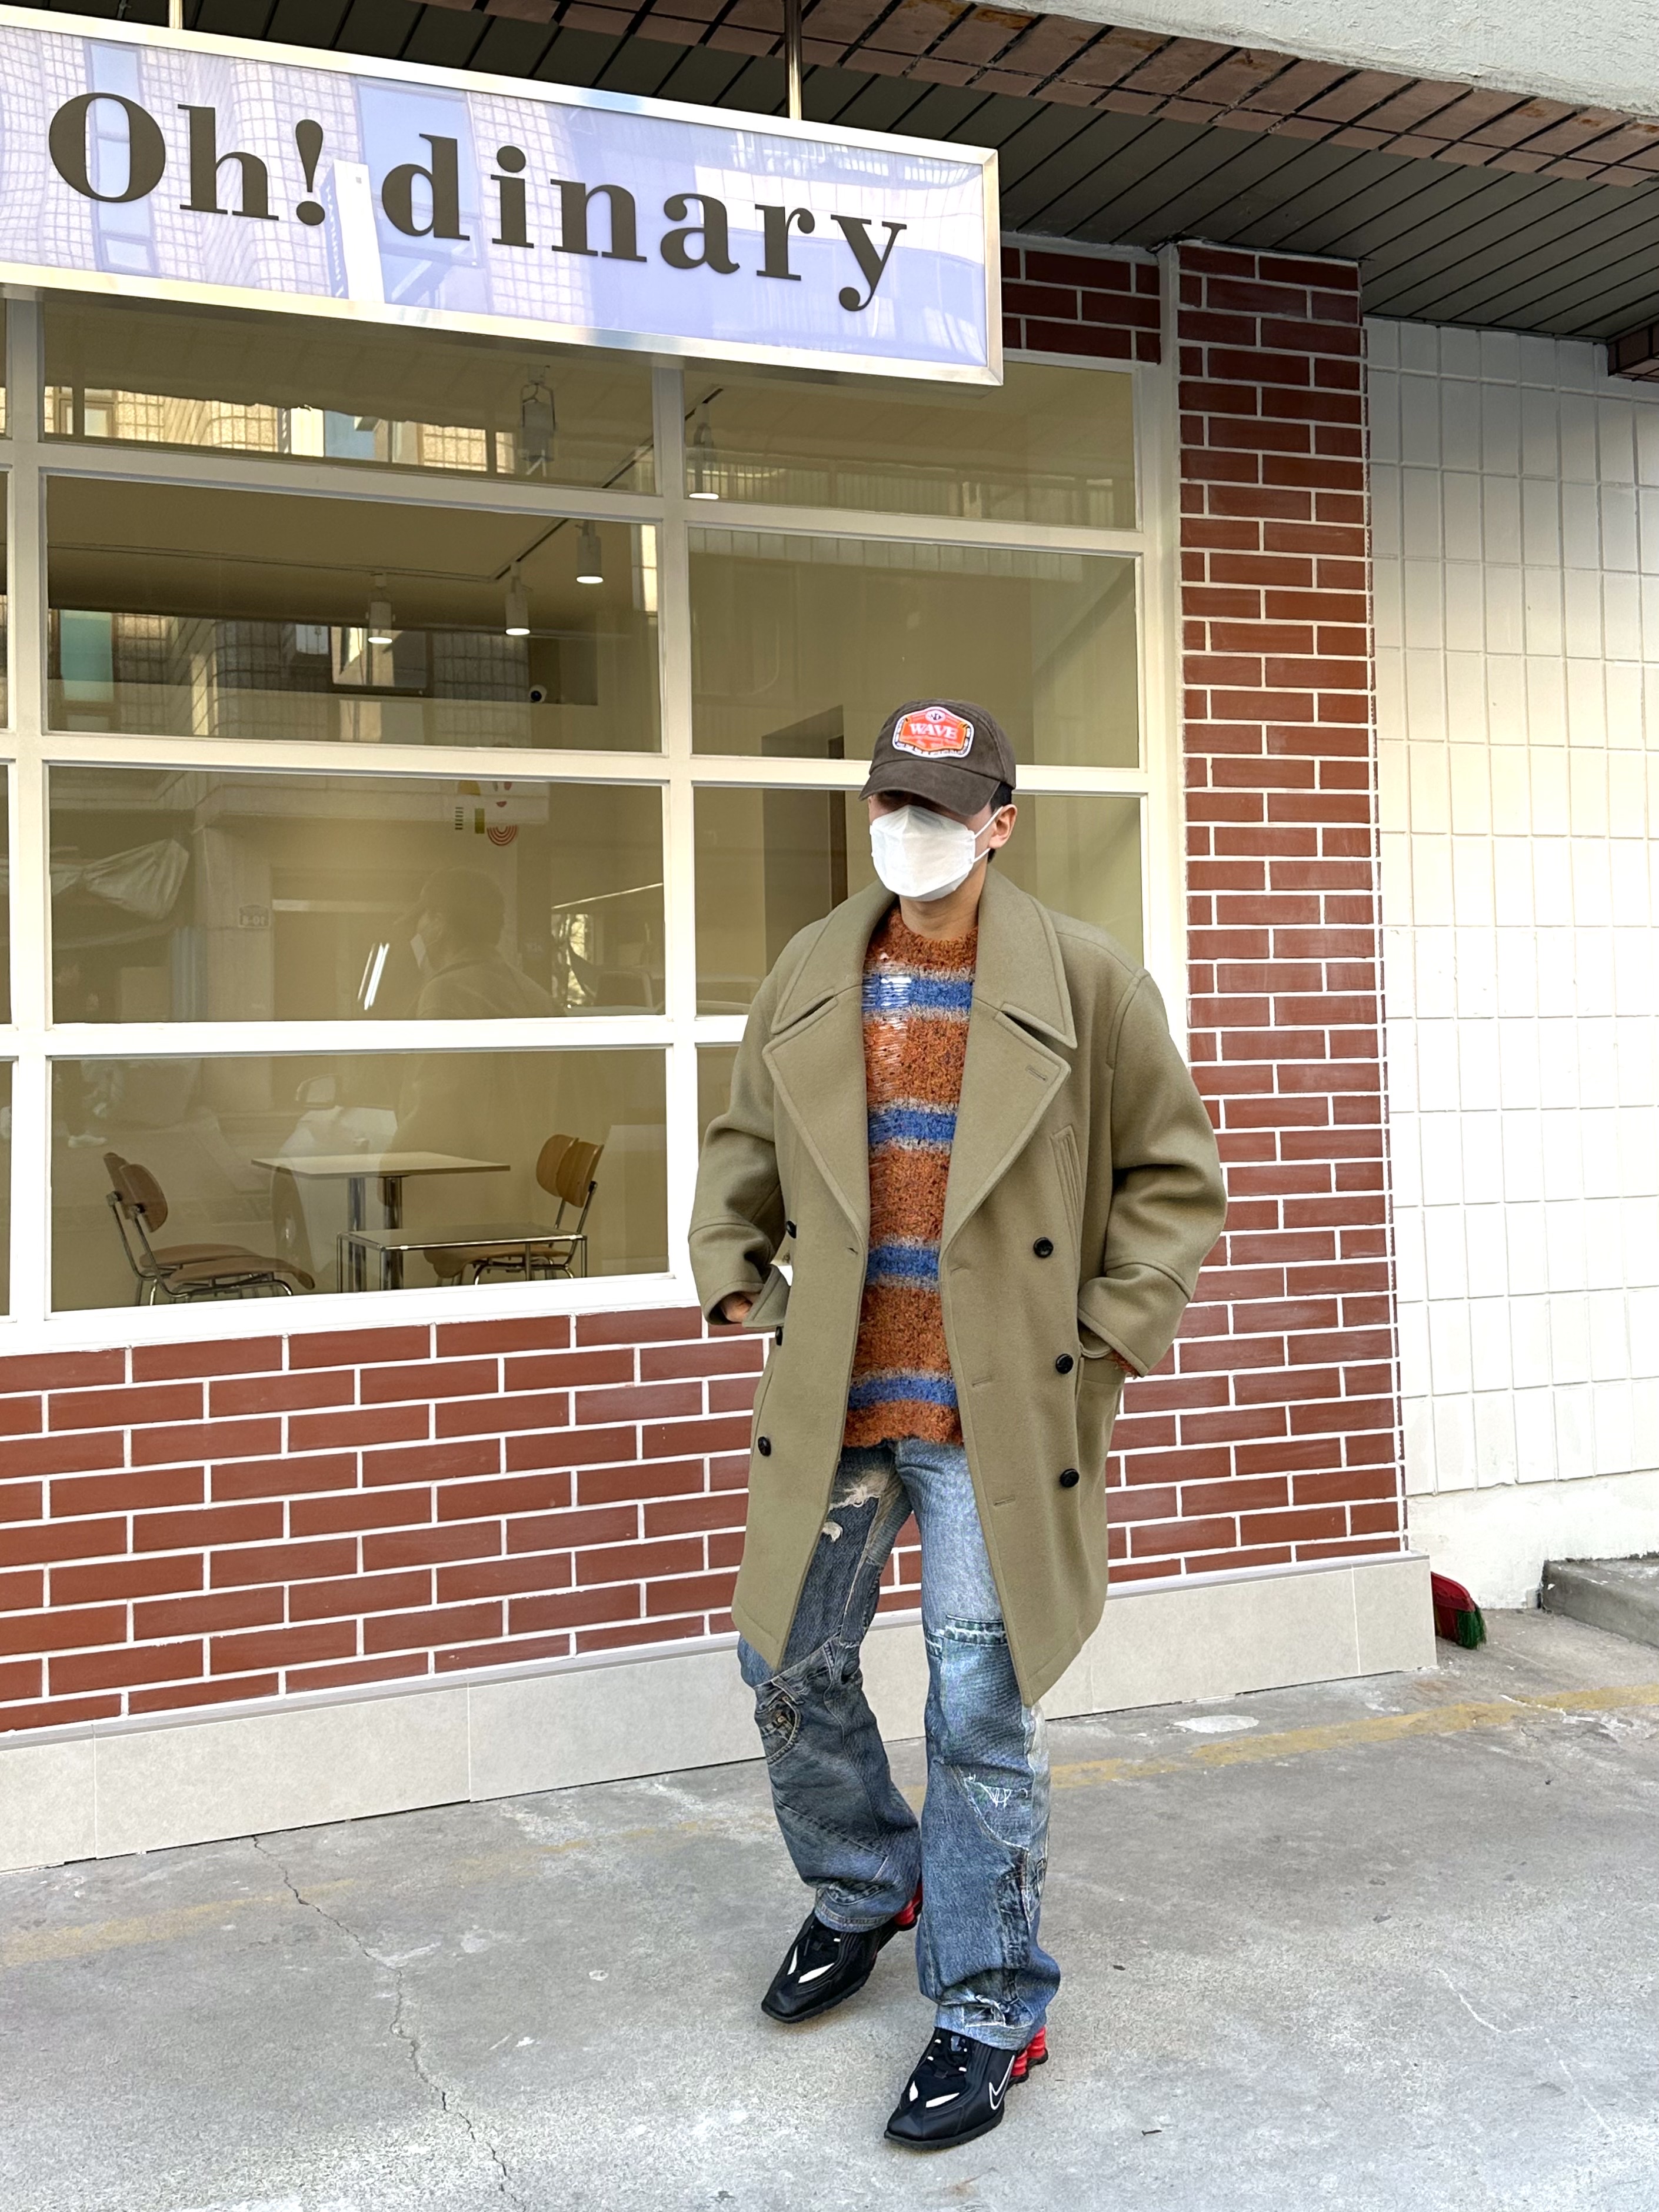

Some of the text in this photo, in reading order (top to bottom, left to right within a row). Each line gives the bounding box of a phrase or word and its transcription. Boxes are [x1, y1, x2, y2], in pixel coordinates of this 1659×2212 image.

[49, 92, 907, 312] Oh! dinary
[909, 722, 958, 739] WAVE
